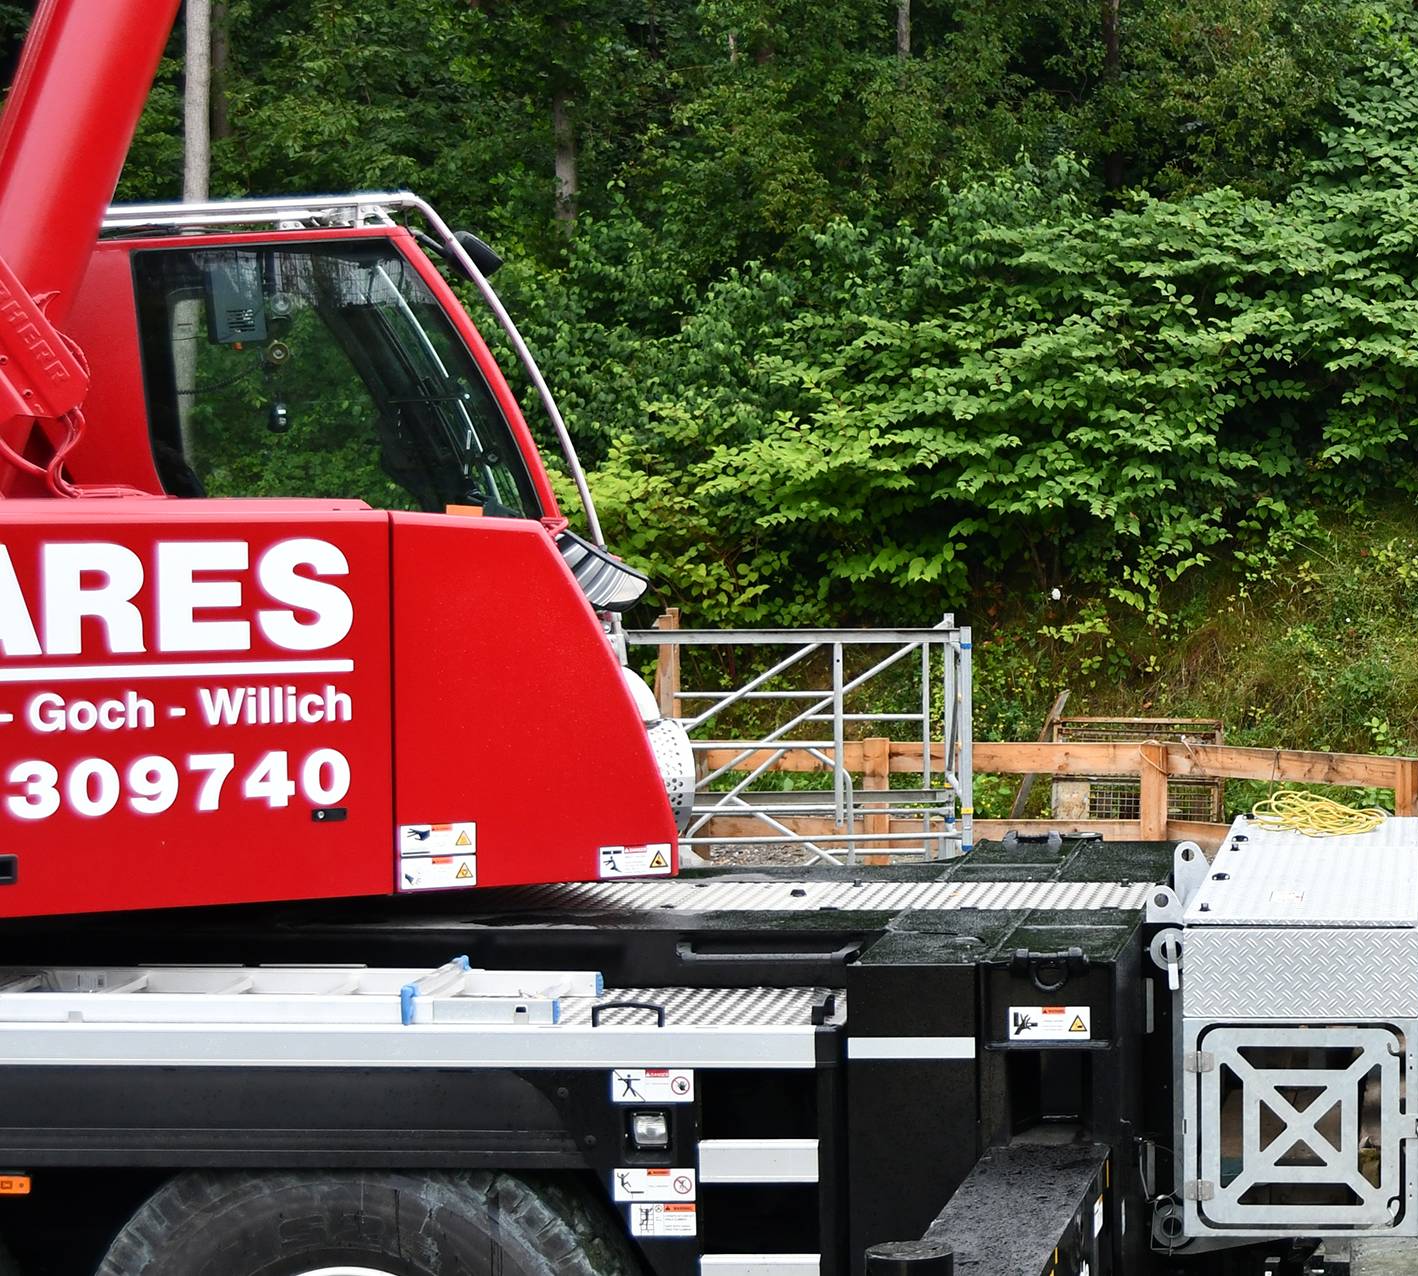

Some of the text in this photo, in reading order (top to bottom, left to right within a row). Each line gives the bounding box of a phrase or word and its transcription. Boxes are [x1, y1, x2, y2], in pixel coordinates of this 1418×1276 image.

[27, 691, 155, 732] Goch
[200, 686, 353, 726] Willich
[7, 748, 352, 821] 309740
